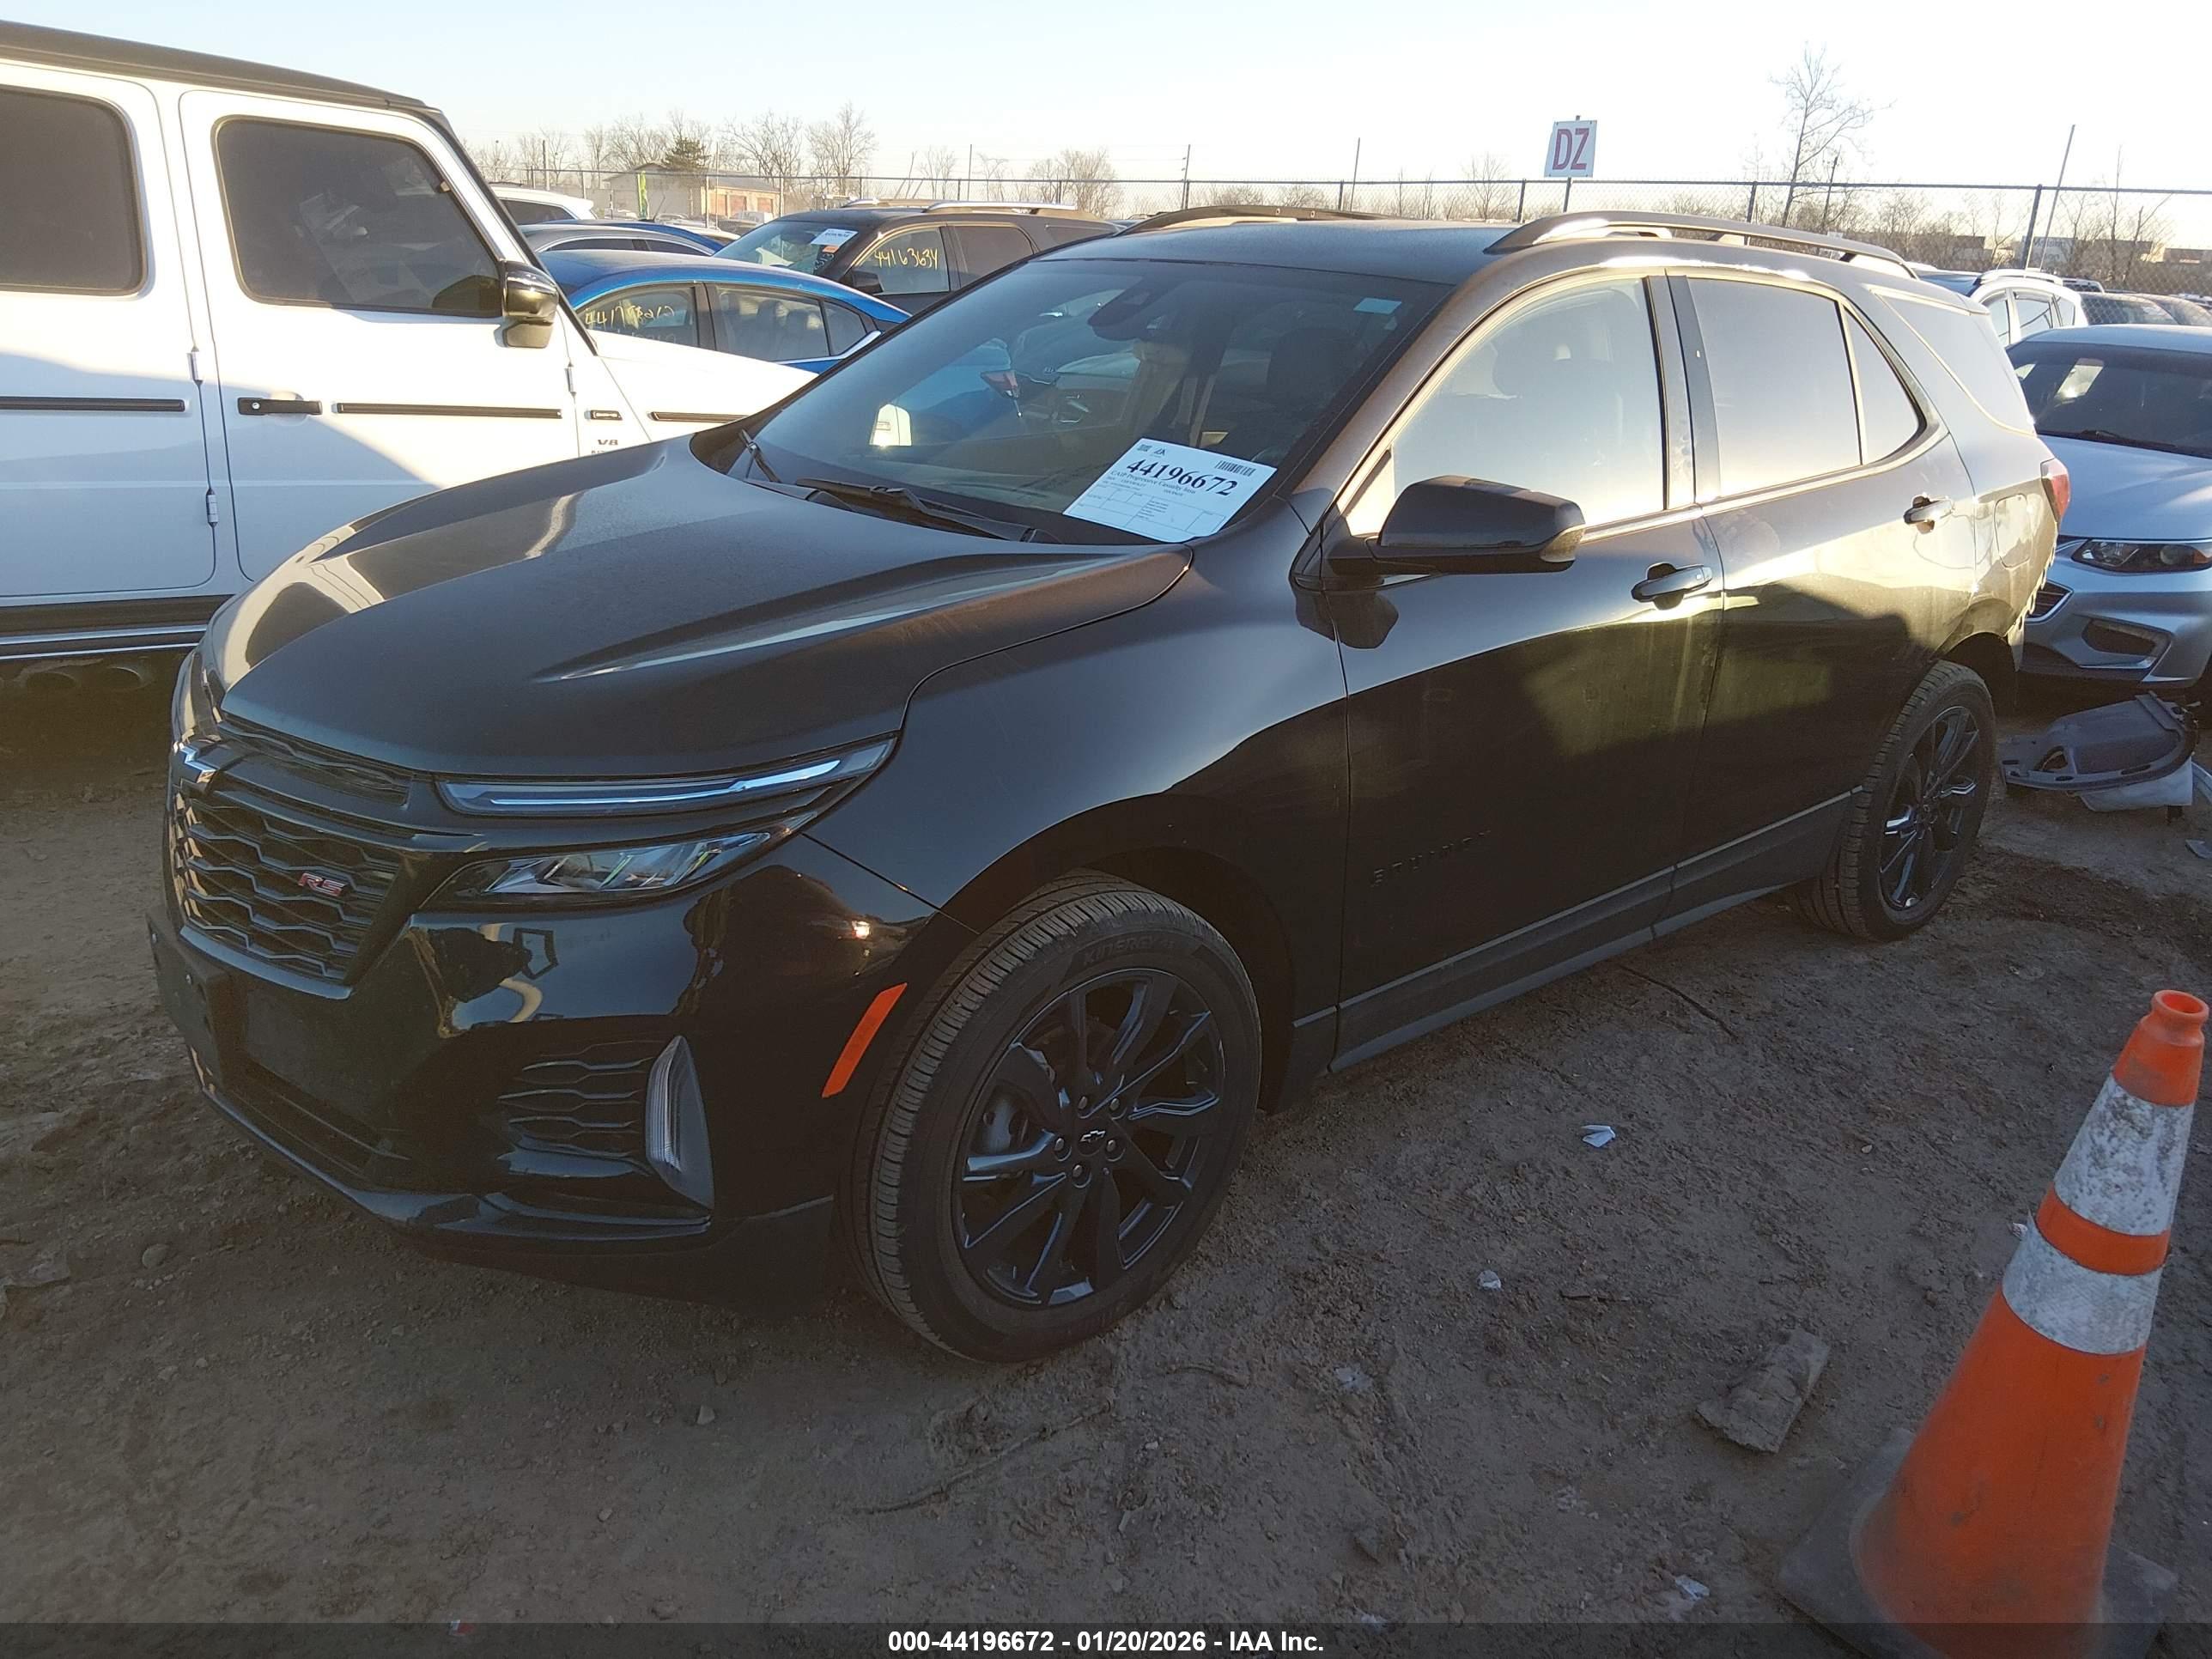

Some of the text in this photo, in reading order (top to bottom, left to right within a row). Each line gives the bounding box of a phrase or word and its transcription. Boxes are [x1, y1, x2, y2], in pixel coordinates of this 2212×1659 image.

[1552, 127, 1589, 170] DZ
[1127, 459, 1238, 496] 44196672
[299, 872, 344, 896] RS
